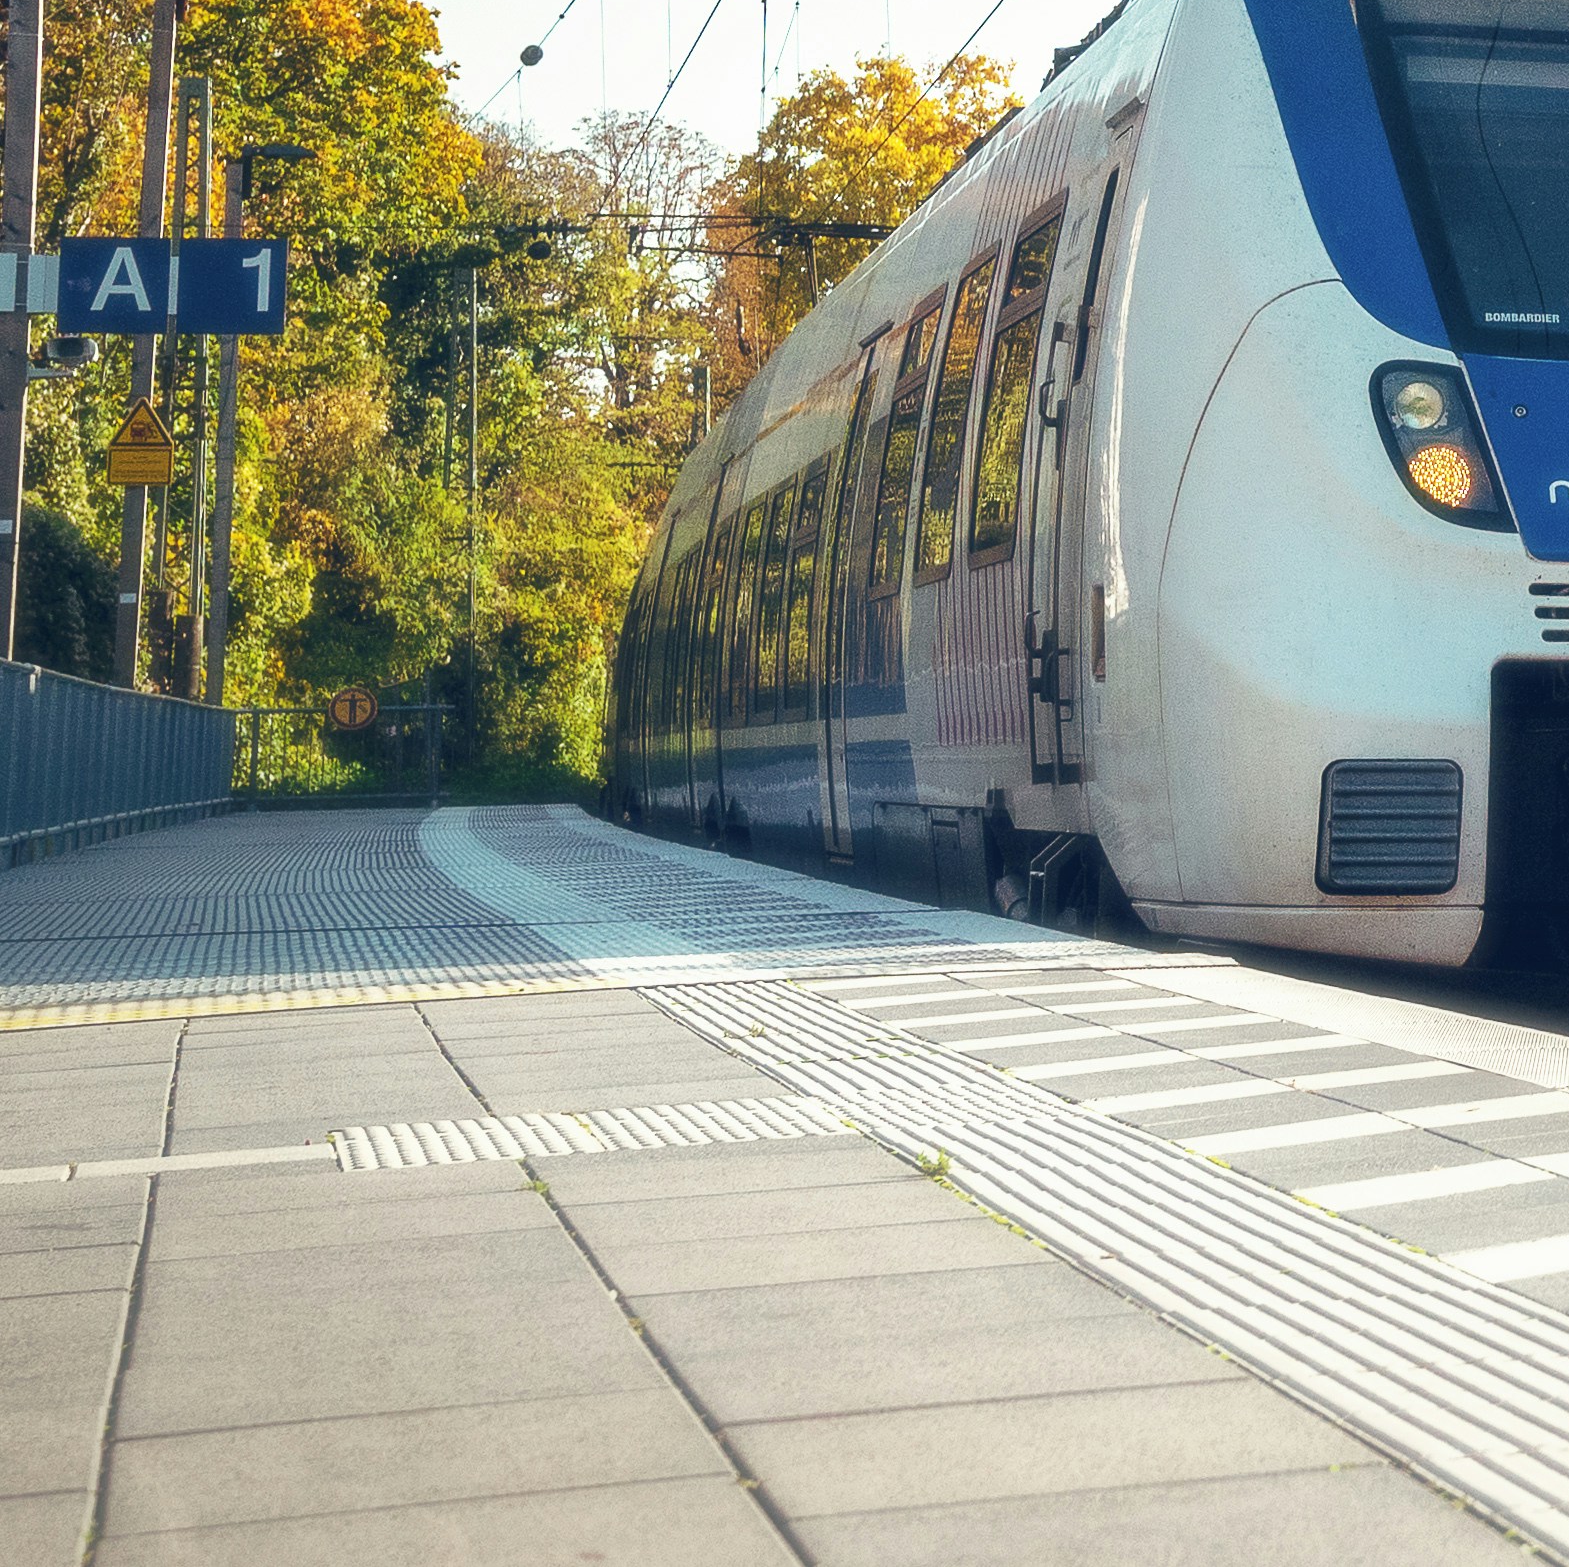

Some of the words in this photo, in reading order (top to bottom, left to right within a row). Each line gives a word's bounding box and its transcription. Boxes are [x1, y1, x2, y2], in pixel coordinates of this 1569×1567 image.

[90, 246, 152, 312] A
[242, 248, 271, 312] 1
[1484, 312, 1560, 324] BOMBARDIER
